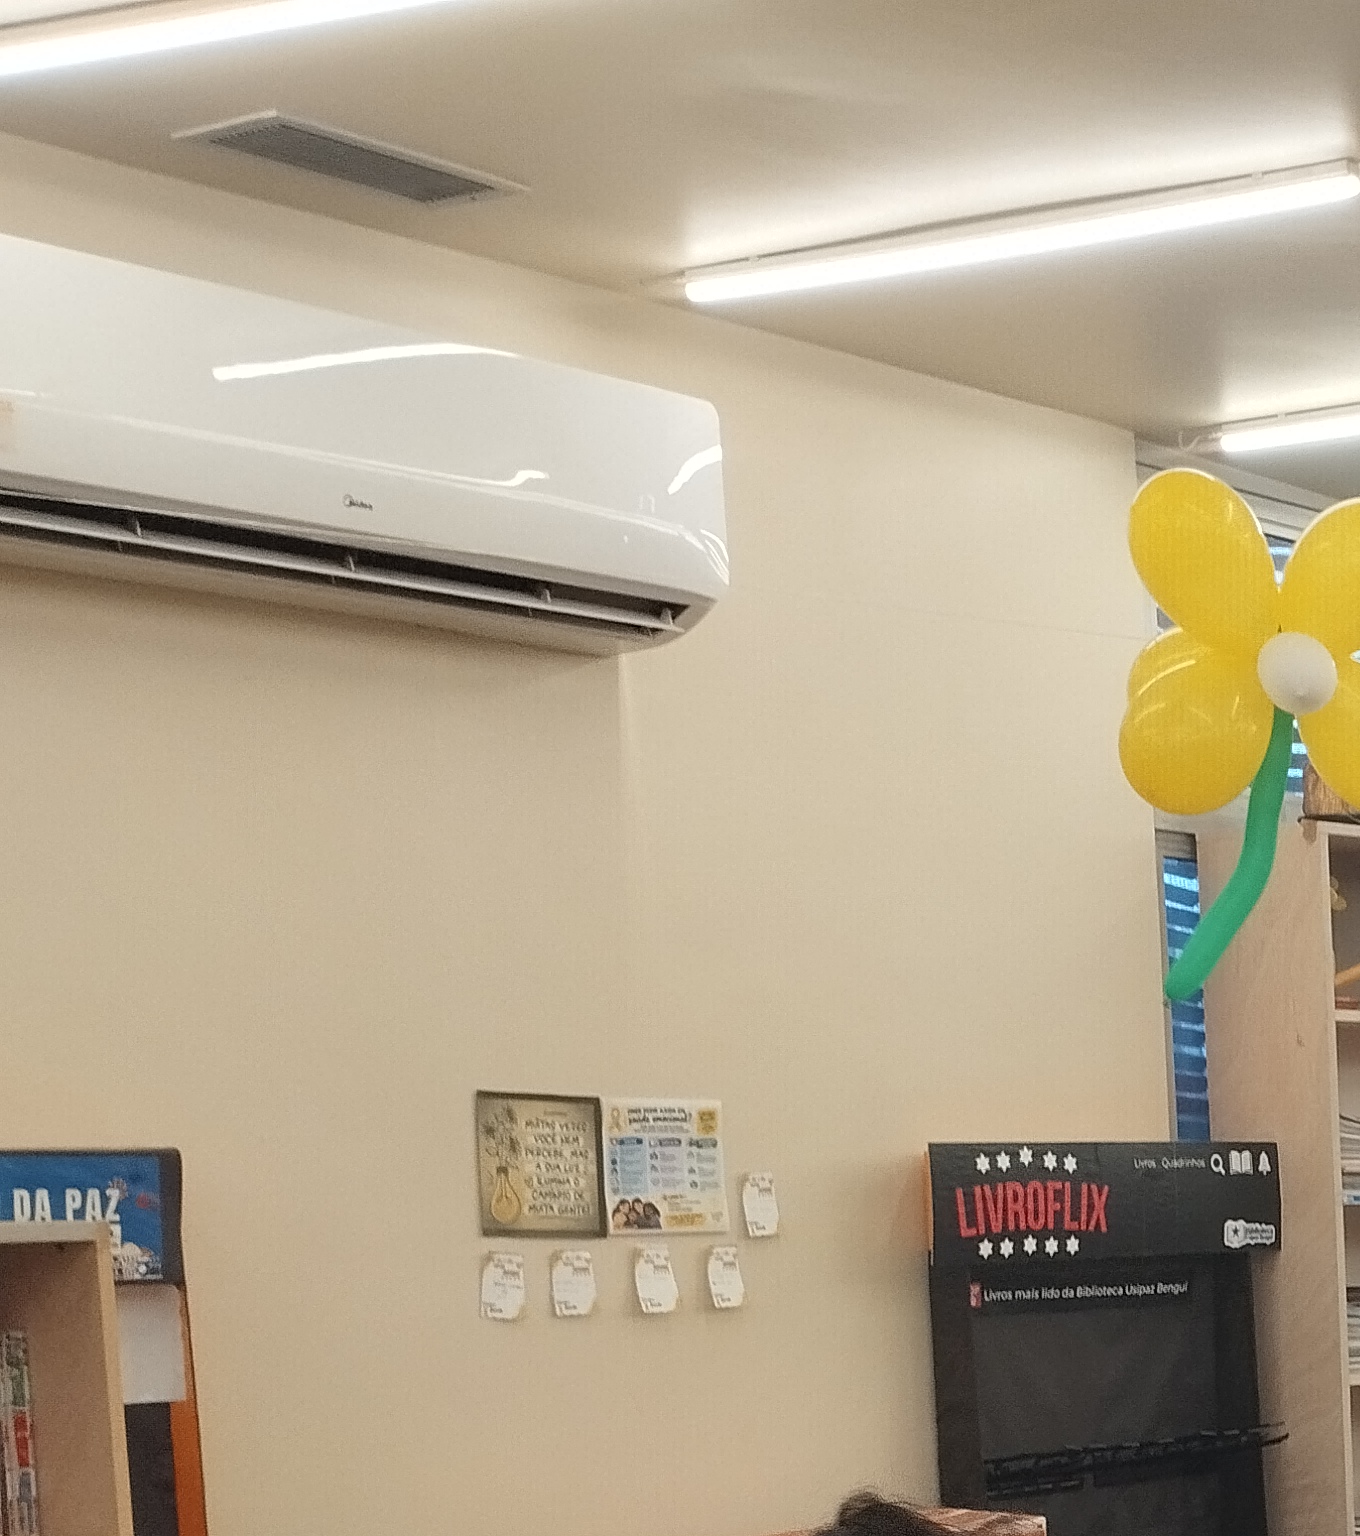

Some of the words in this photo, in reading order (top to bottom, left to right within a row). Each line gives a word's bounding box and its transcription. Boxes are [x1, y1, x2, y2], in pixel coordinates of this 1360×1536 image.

[13, 1187, 52, 1222] DA
[65, 1187, 121, 1222] PAZ
[955, 1180, 1110, 1238] LIVROFLIX
[983, 1287, 1013, 1302] Livros
[1014, 1287, 1040, 1300] mais
[1061, 1285, 1075, 1299] da
[1076, 1283, 1123, 1298] Biblioteca
